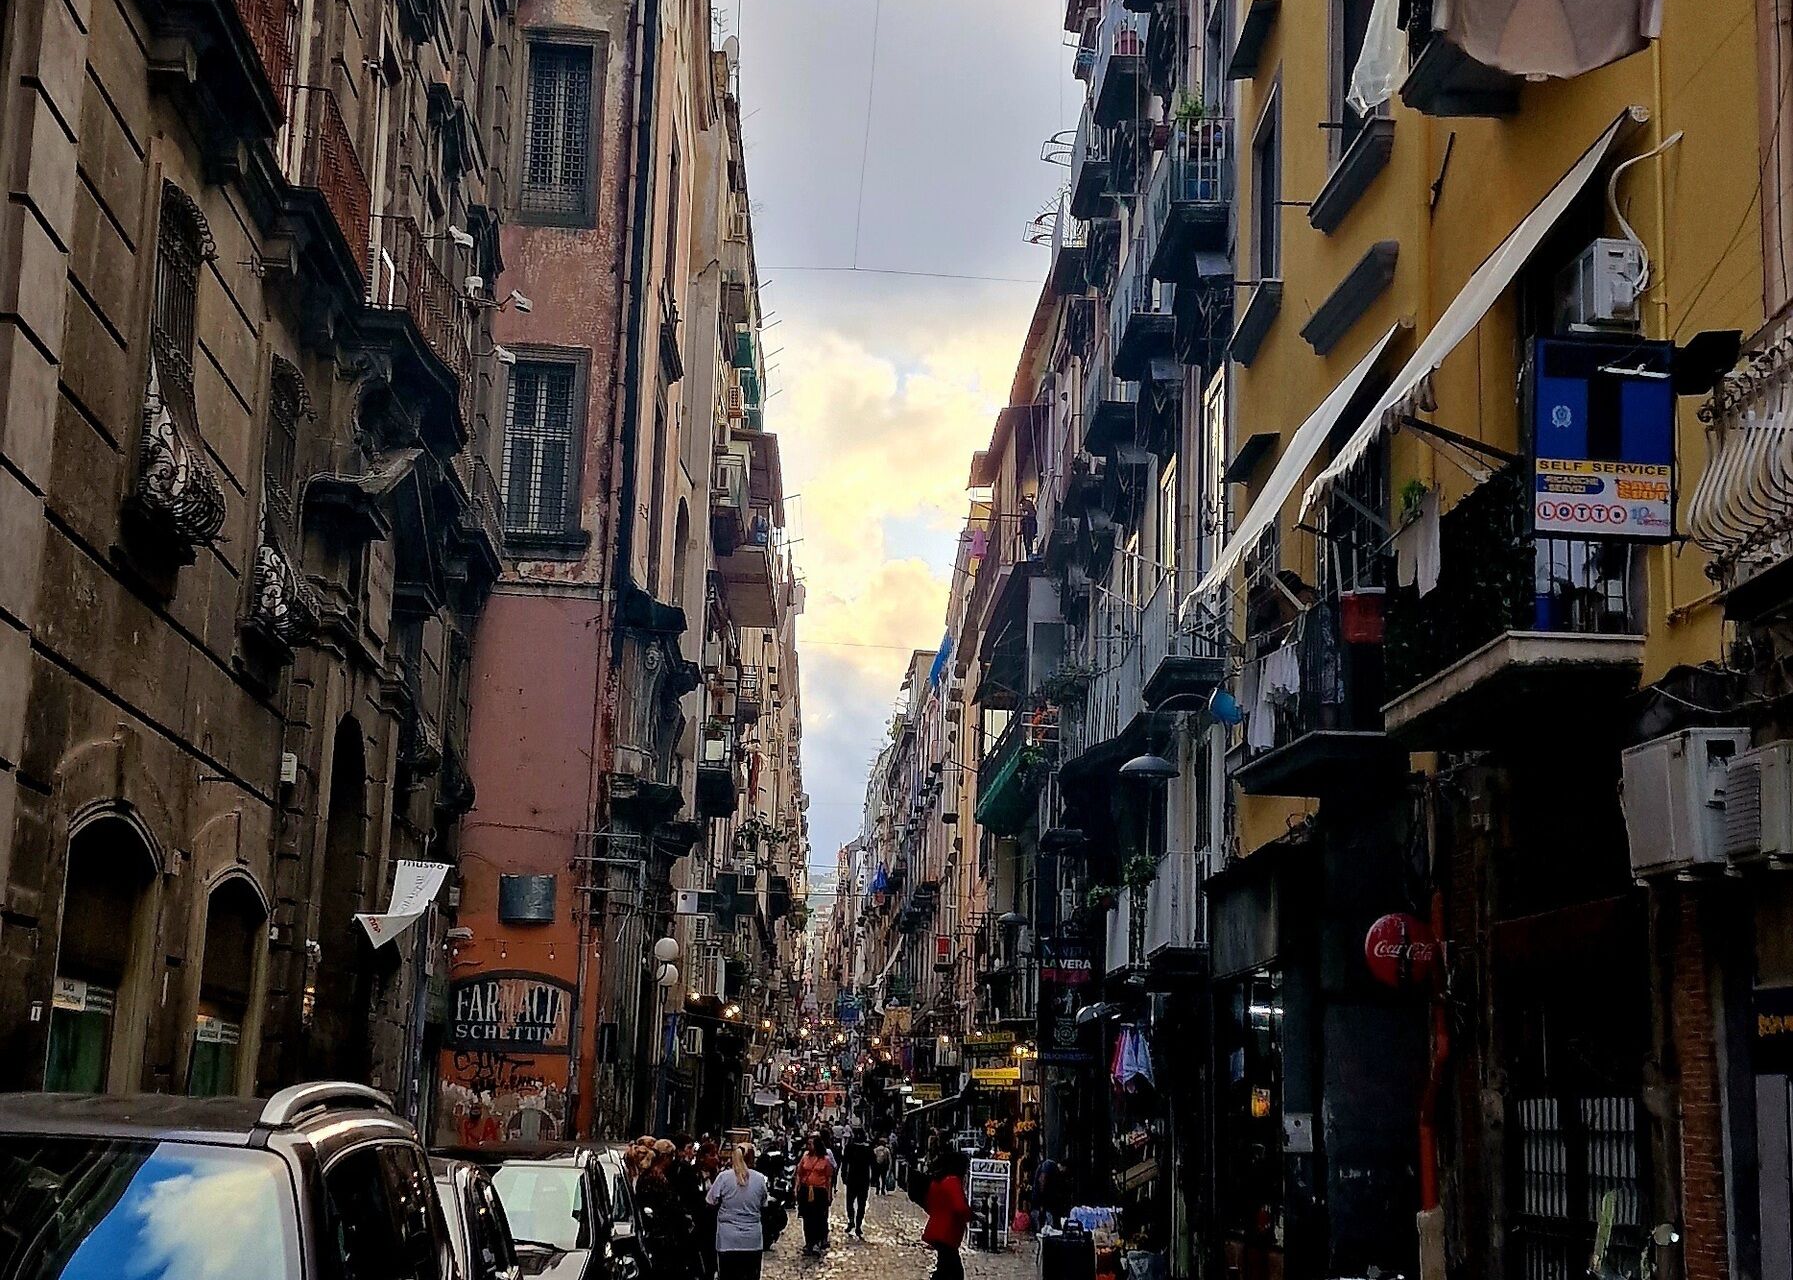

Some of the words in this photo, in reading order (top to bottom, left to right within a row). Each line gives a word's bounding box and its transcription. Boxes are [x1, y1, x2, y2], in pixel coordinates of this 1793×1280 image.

[1539, 460, 1583, 472] SELF
[1592, 462, 1668, 476] SERVICE
[1540, 503, 1624, 522] LOTTO
[402, 860, 444, 870] museo
[1058, 959, 1092, 970] VERA
[455, 981, 568, 1024] FARMACIA
